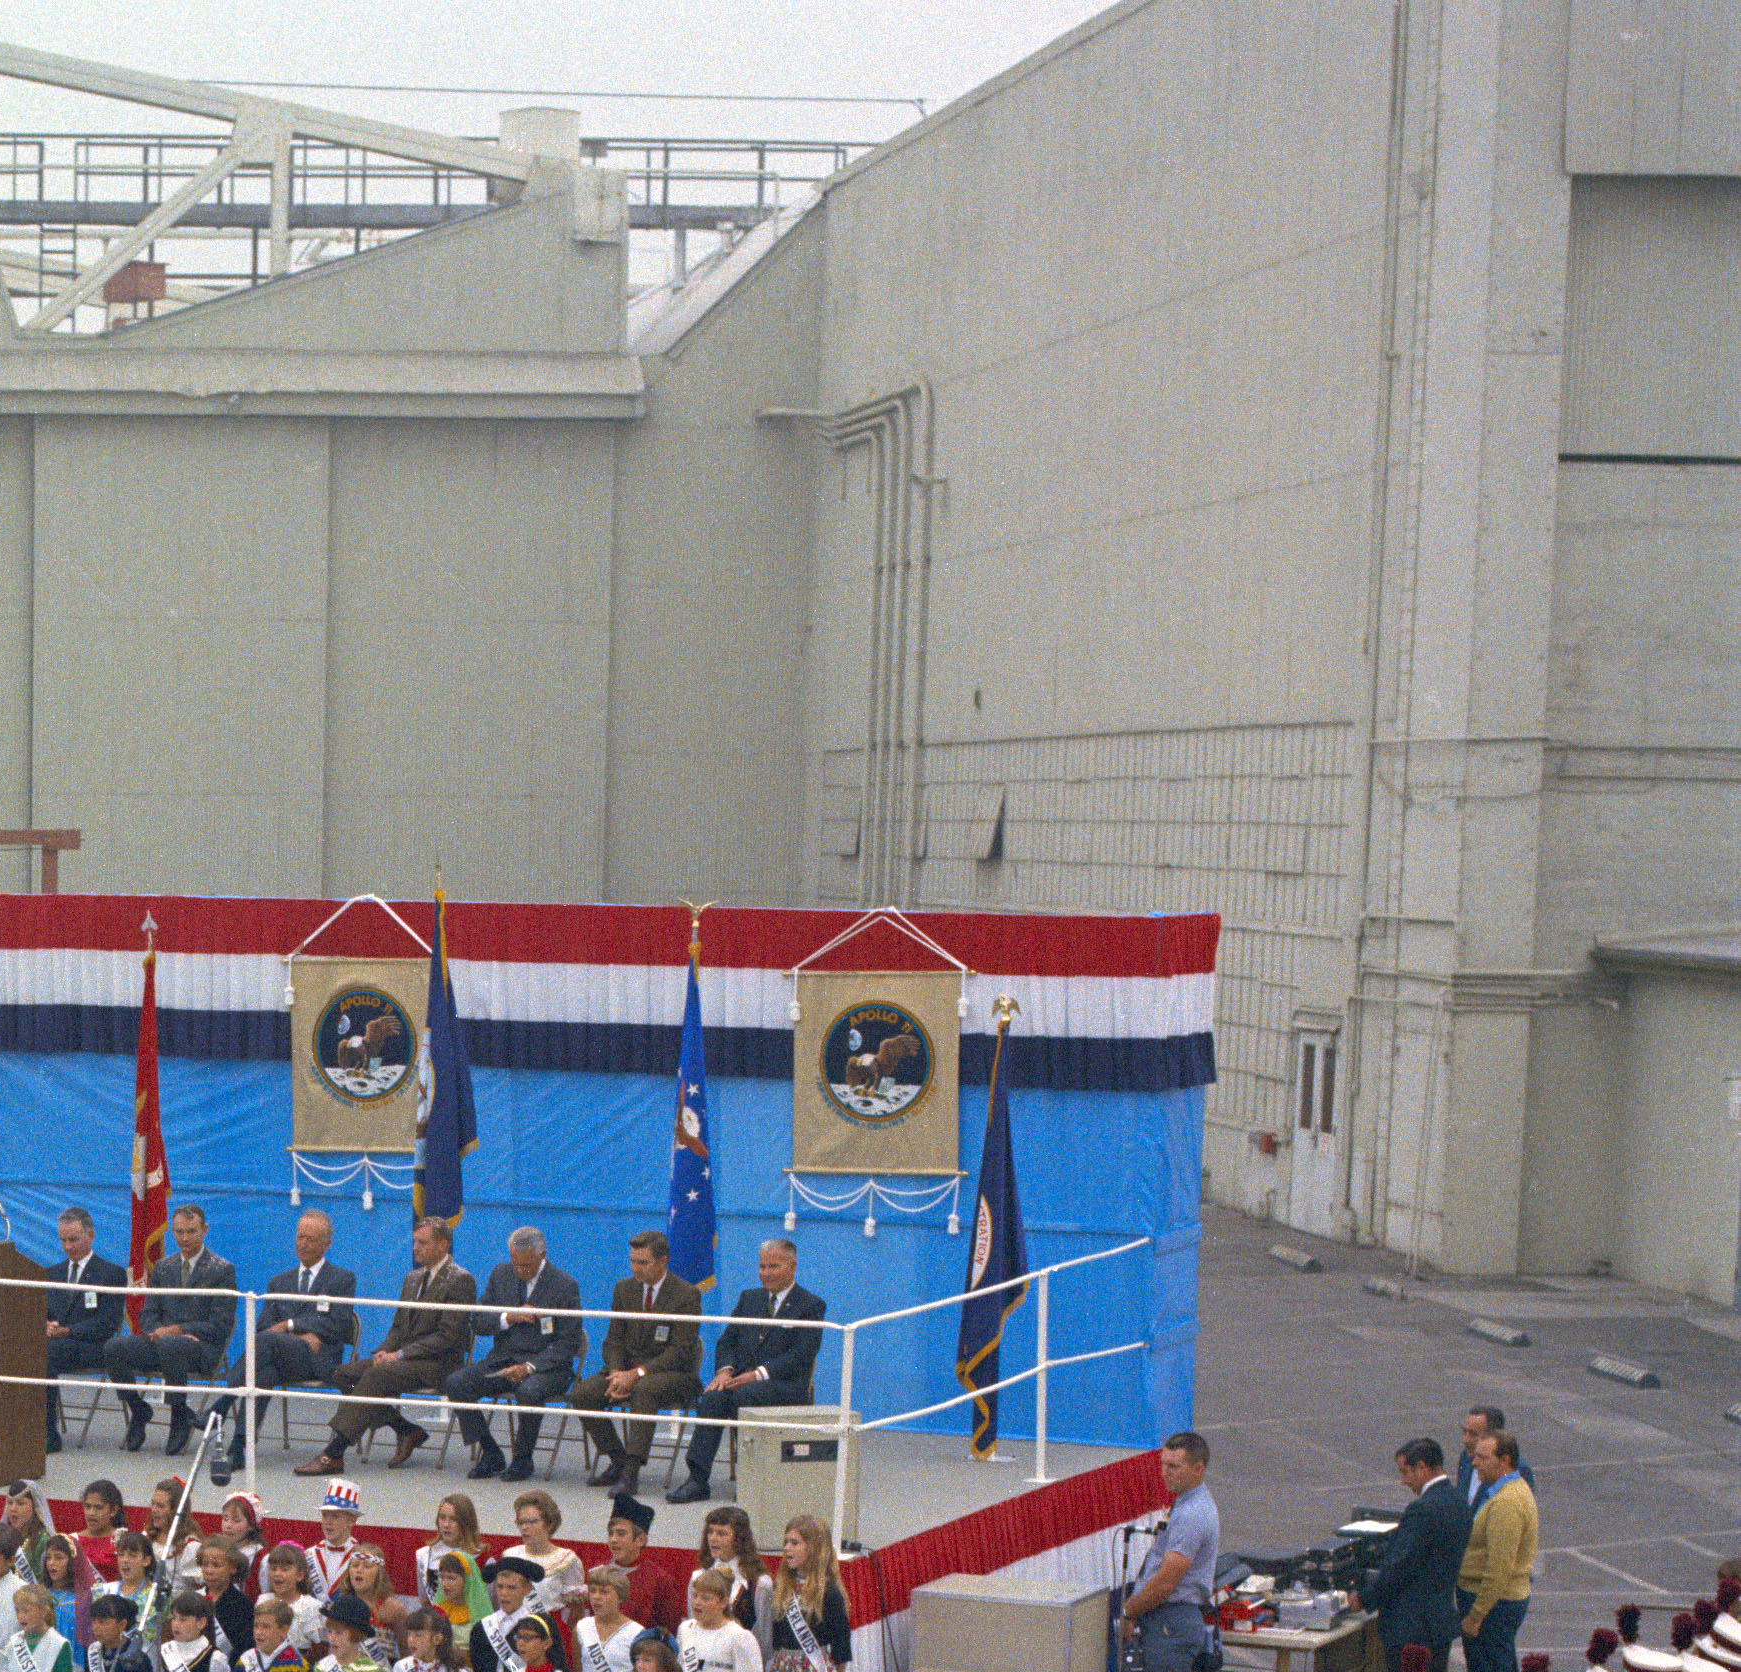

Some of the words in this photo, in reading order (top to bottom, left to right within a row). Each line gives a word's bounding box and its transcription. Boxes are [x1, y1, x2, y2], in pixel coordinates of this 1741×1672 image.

[340, 995, 381, 1012] APOLLO
[849, 1009, 899, 1026] APOLLO
[308, 1557, 323, 1594] UNITED
[489, 1630, 514, 1663] SPAIN
